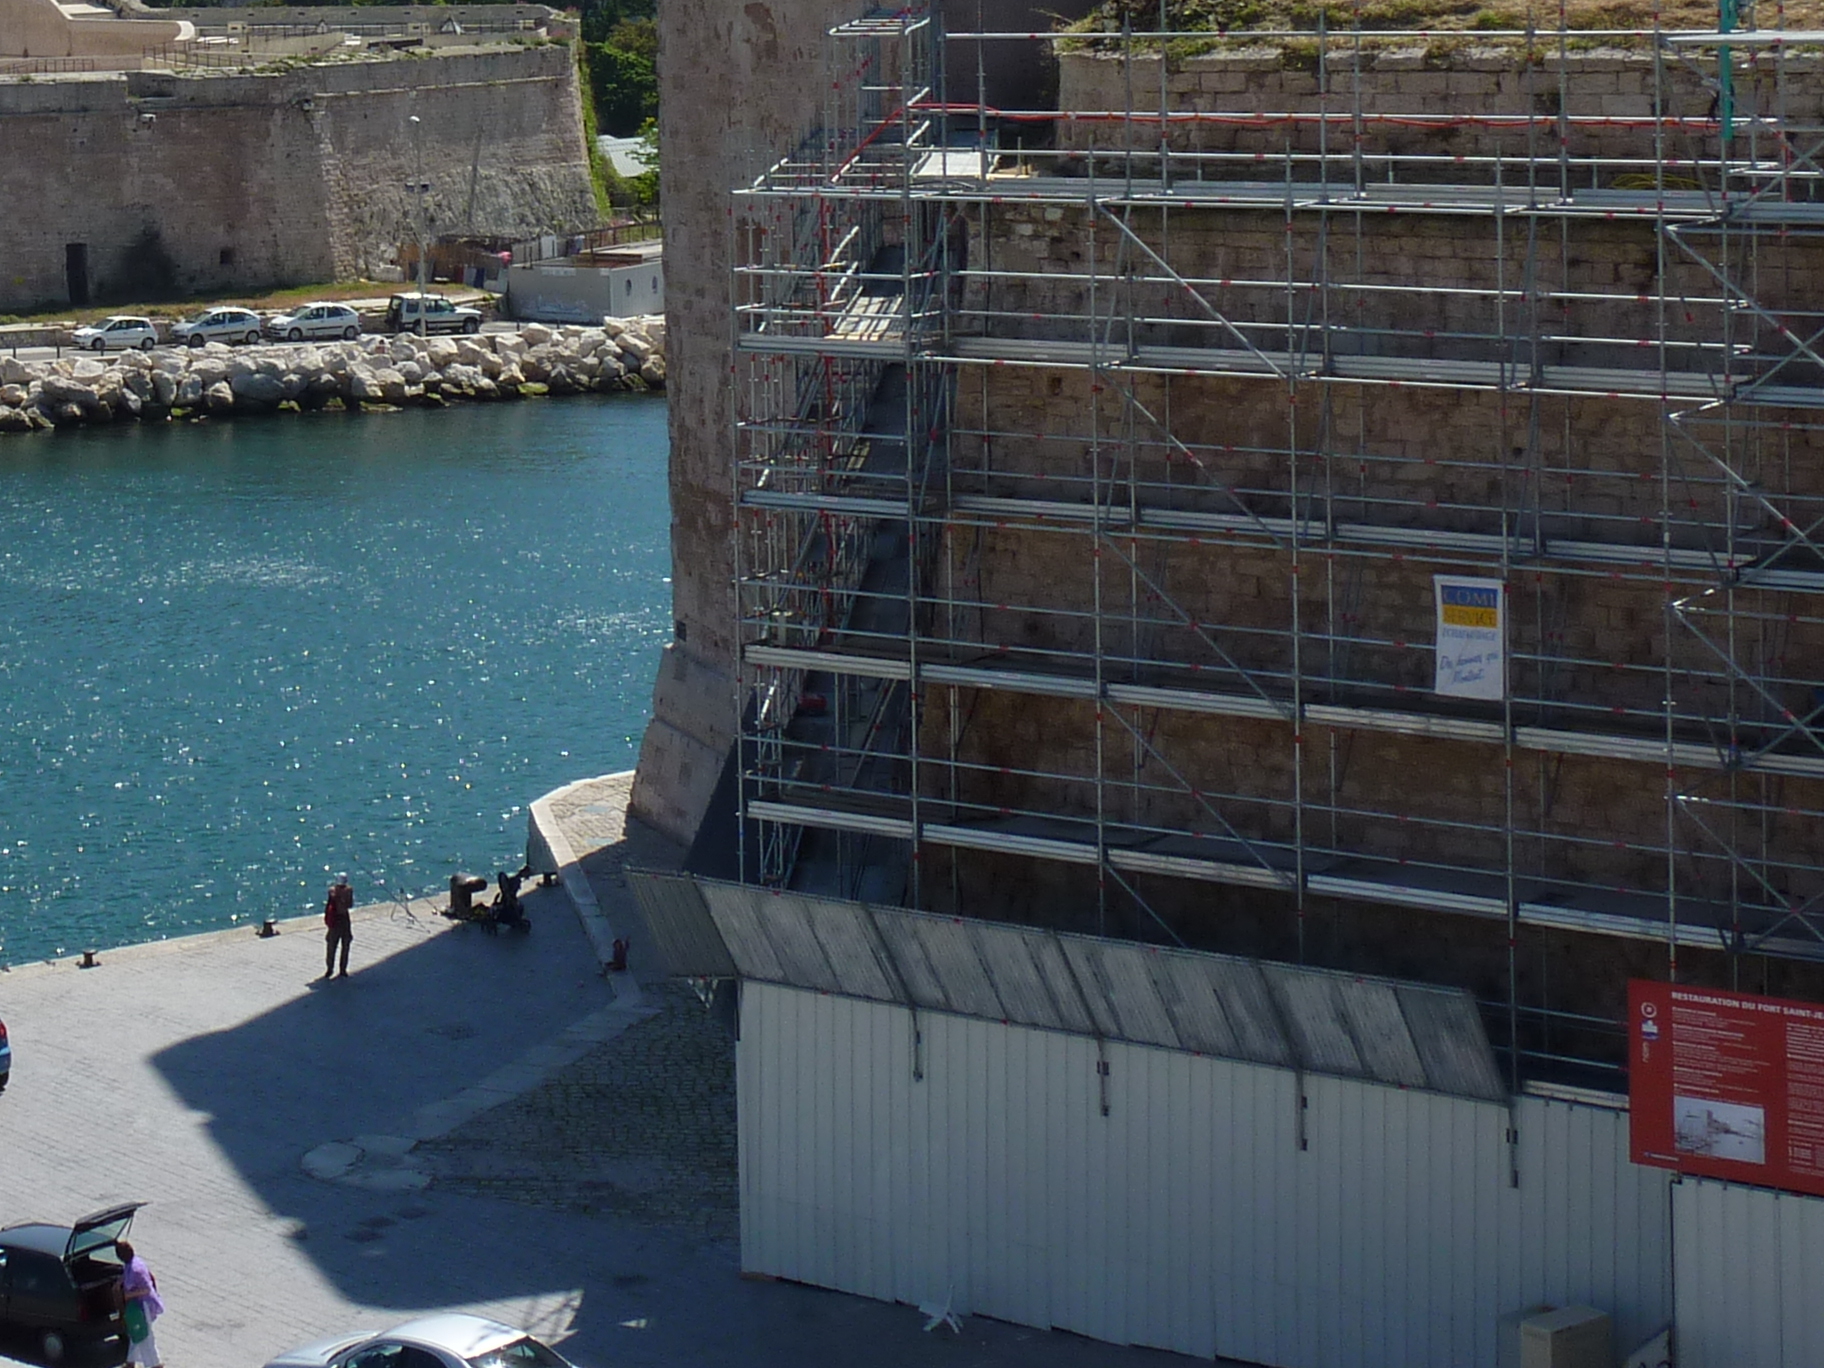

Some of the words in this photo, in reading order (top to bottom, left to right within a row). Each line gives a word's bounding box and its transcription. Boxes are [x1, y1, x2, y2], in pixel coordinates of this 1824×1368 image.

[1443, 589, 1495, 606] COMI
[1671, 991, 1740, 1008] RESTAURATION
[1741, 1001, 1756, 1010] DU
[1758, 1003, 1781, 1013] FORT
[1783, 1007, 1824, 1020] SAINT-JE
